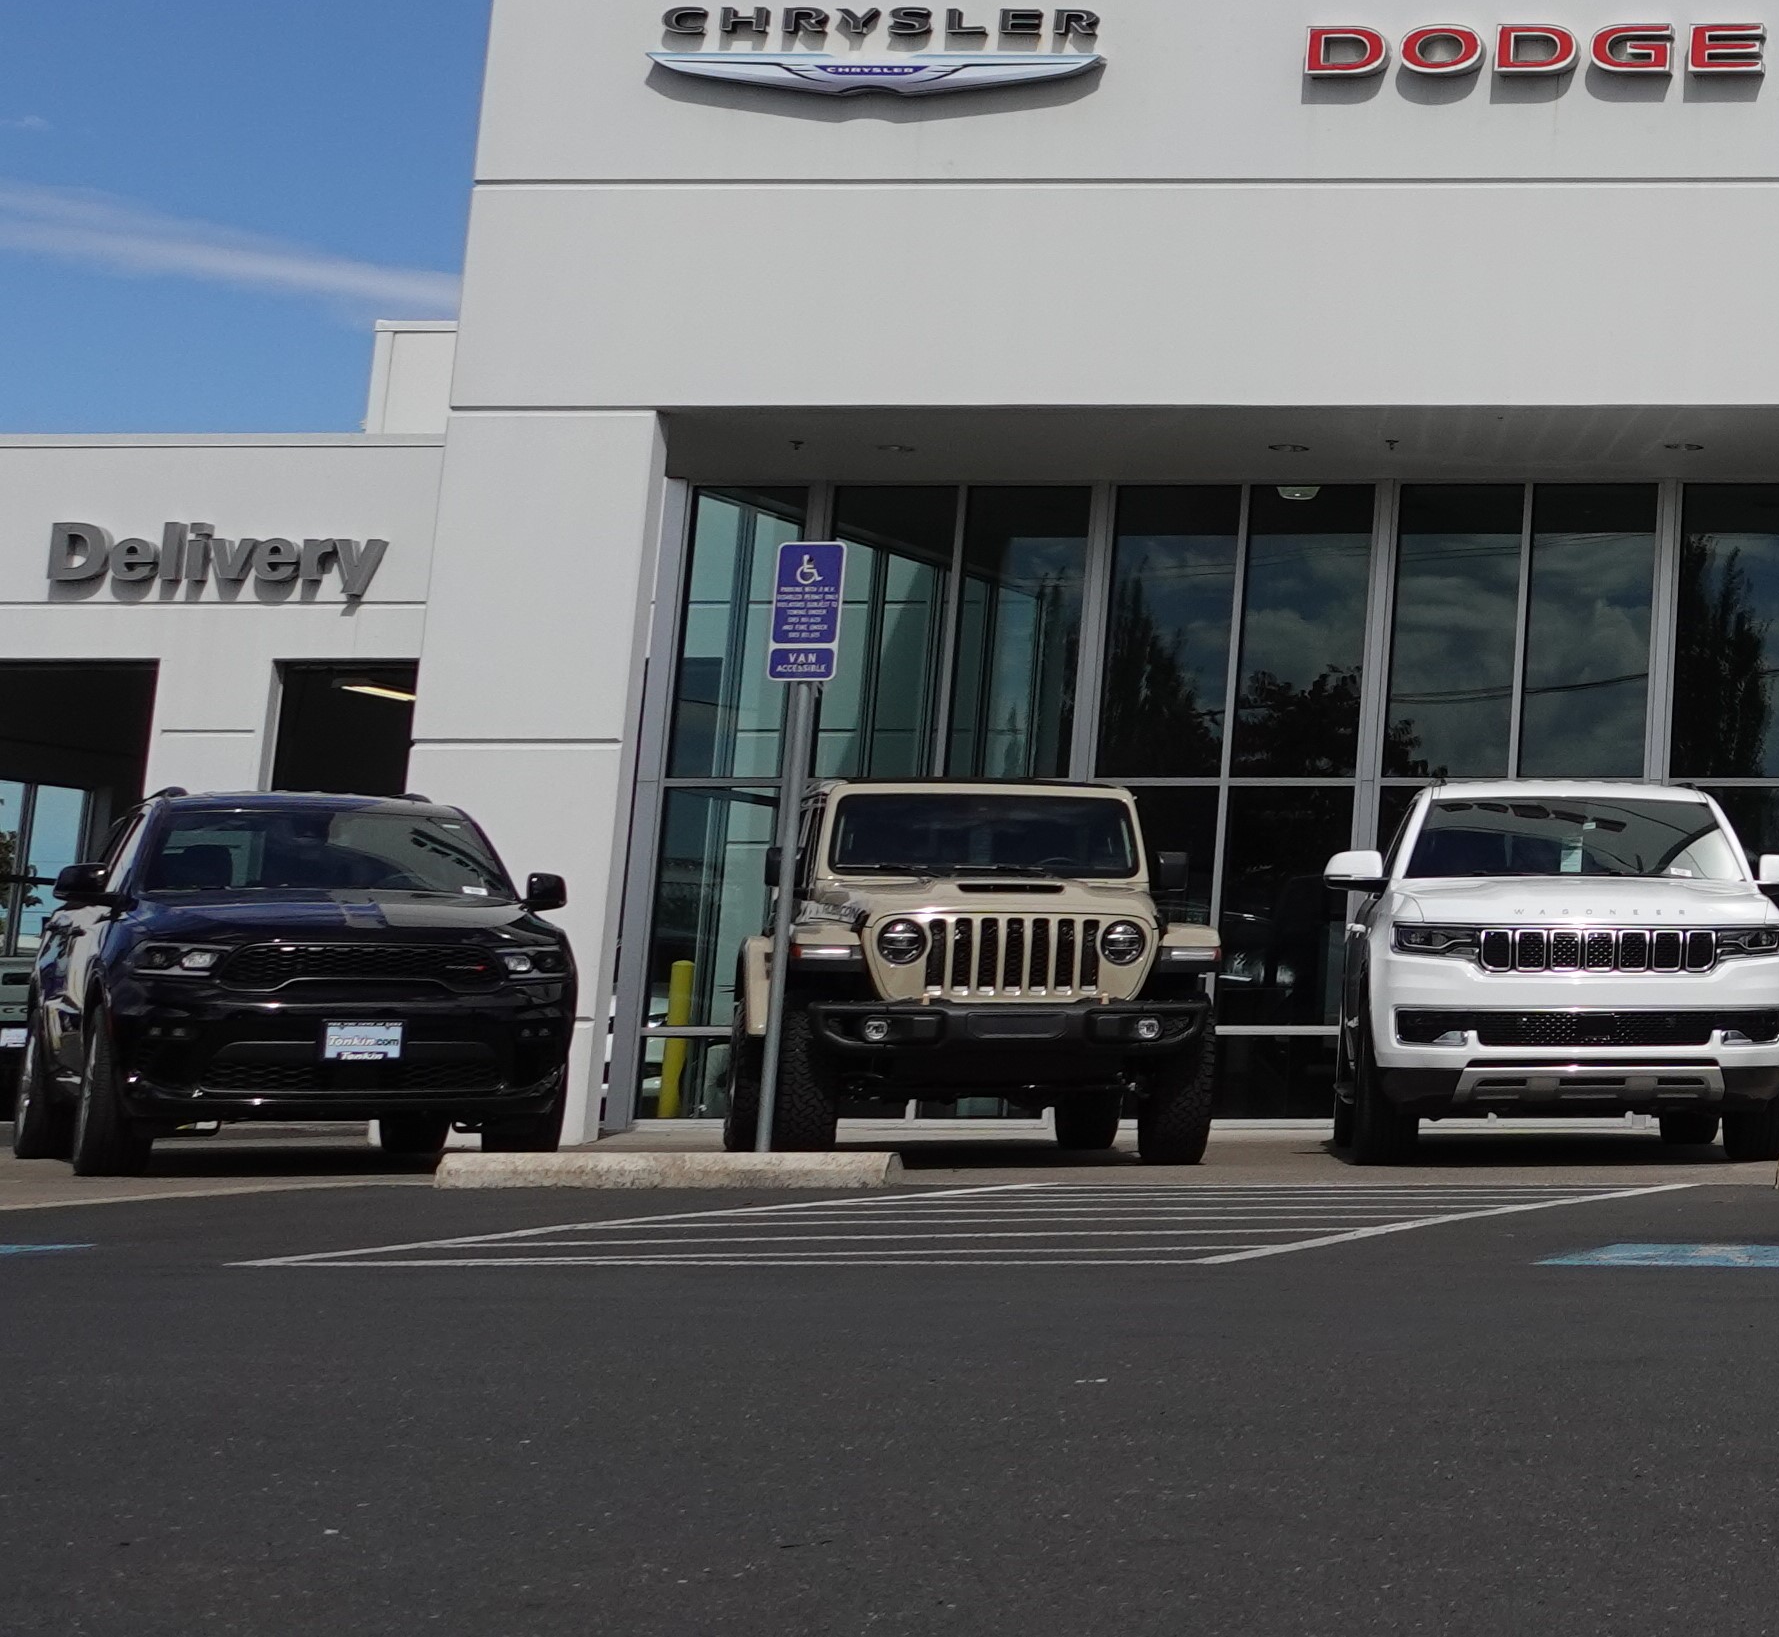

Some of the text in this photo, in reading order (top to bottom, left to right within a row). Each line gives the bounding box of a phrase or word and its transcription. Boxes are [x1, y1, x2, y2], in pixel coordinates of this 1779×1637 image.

[660, 5, 1101, 36] CHRYSLER
[1304, 22, 1767, 77] DODGE
[46, 521, 390, 598] Delivery
[788, 652, 817, 663] VAN
[775, 664, 826, 673] ACCESSIBLE
[327, 1035, 400, 1046] Tonkin.com
[340, 1051, 385, 1061] Tonkin
